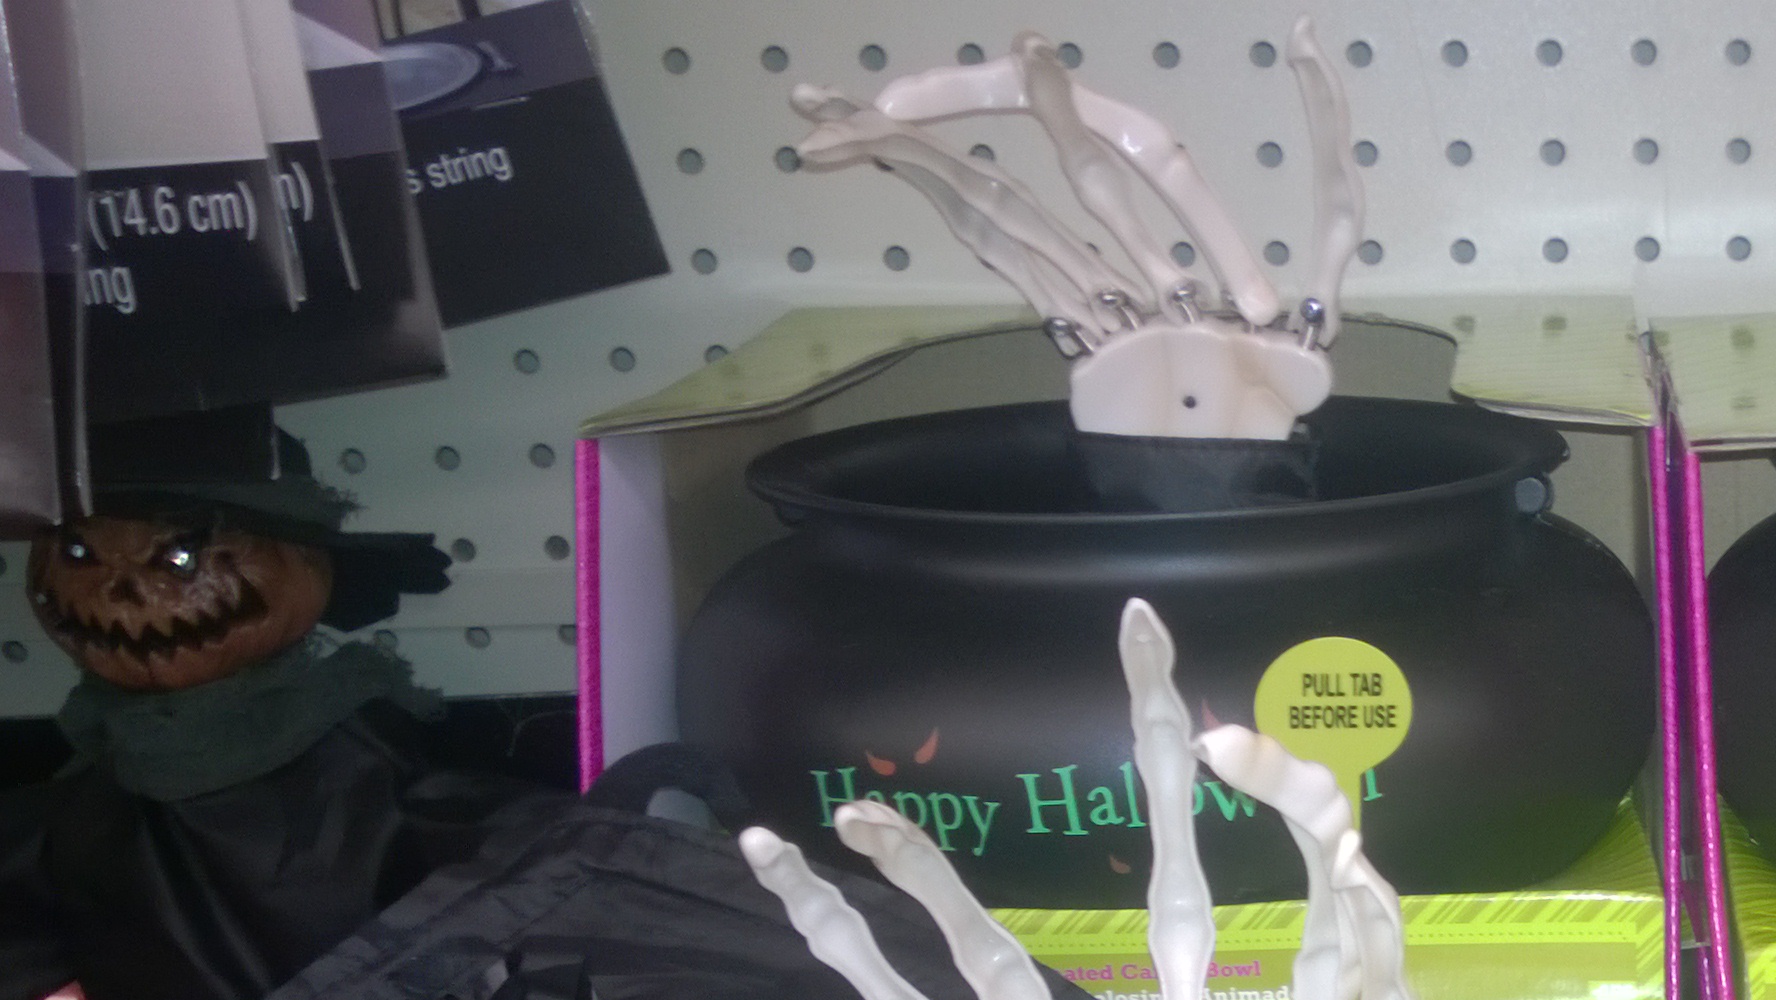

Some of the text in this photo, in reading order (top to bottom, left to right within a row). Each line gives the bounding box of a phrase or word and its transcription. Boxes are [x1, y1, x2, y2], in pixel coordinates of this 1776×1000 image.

[426, 147, 513, 189] string
[86, 180, 258, 250] (14.6 cm)
[1302, 672, 1384, 698] PULL TAB
[1288, 703, 1398, 730] BEFORE USE
